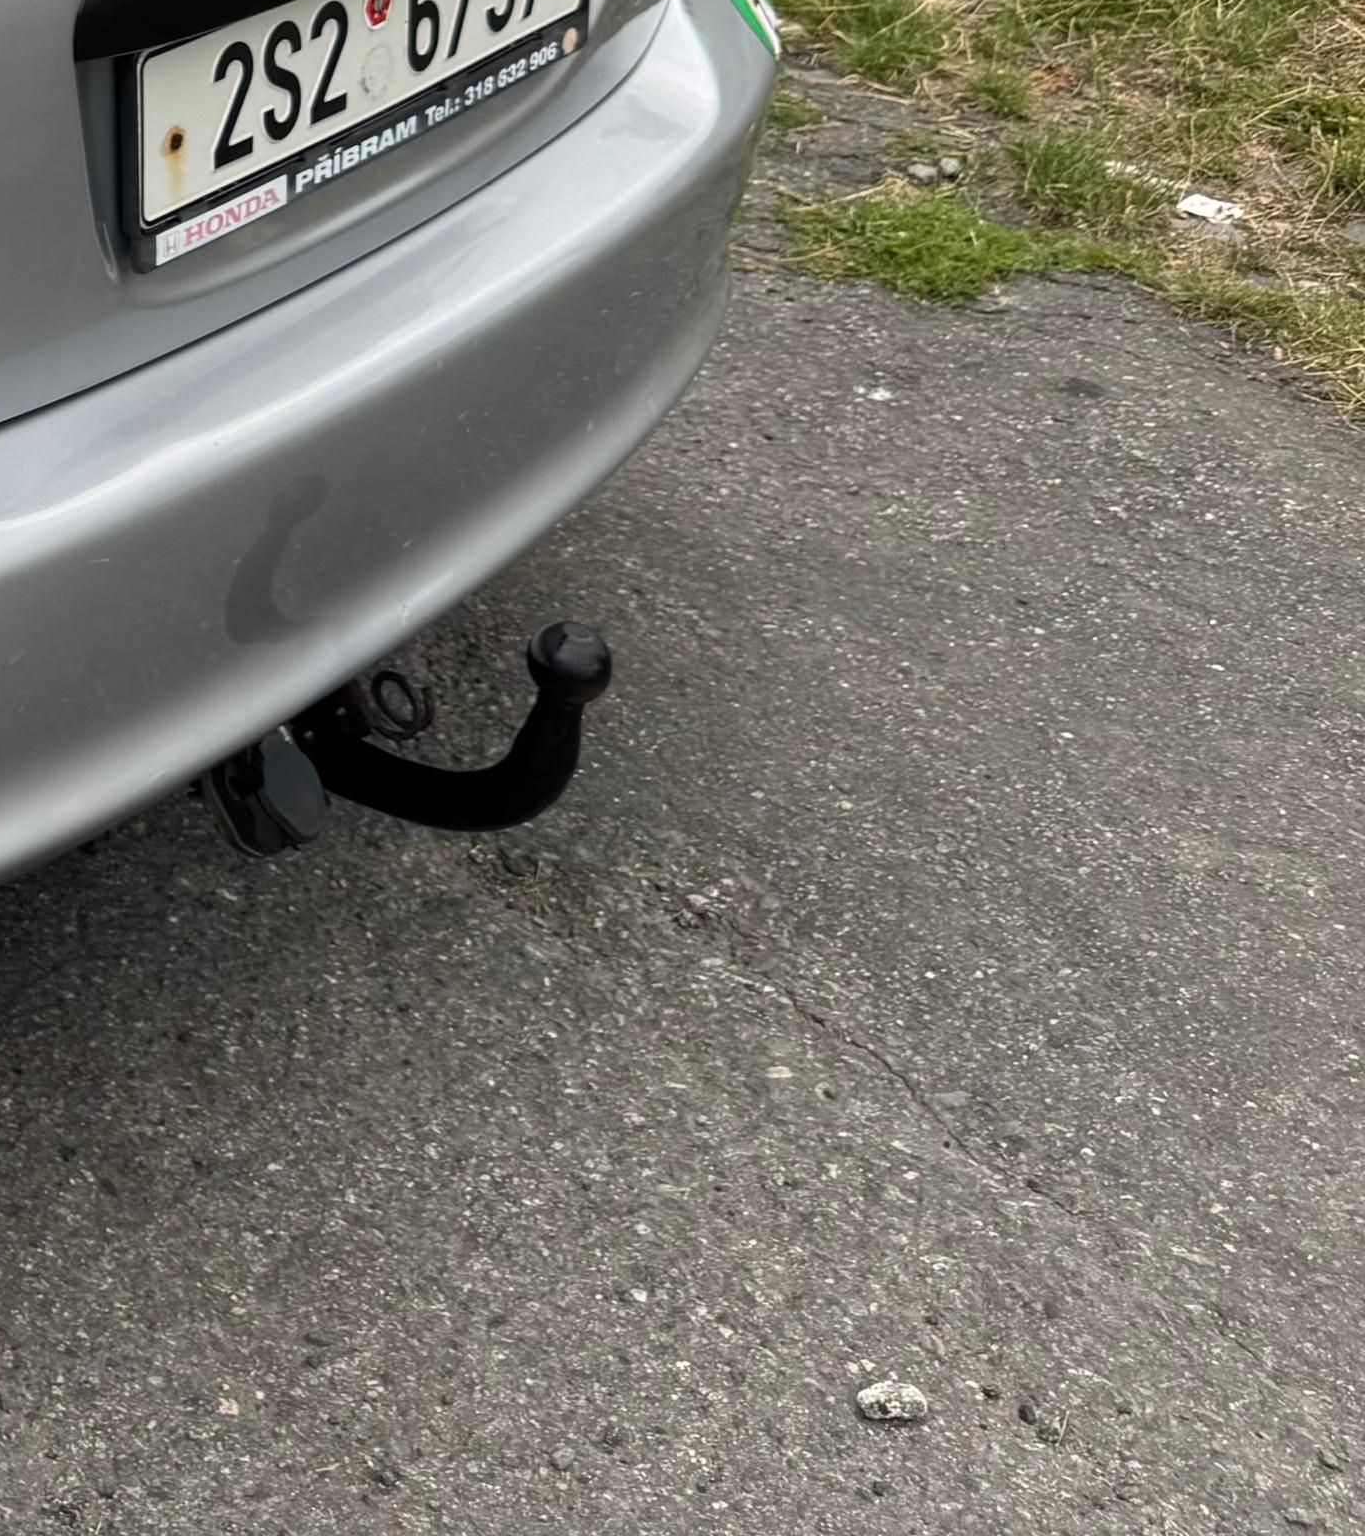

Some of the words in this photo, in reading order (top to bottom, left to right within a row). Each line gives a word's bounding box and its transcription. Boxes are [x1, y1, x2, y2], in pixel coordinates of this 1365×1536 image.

[183, 188, 281, 246] HONDA
[295, 115, 417, 194] PŘÍBRAM
[425, 98, 460, 126] Tel.:
[464, 76, 494, 106] 318
[497, 58, 526, 88] 632
[529, 41, 558, 71] 906
[212, 0, 349, 169] 2S2
